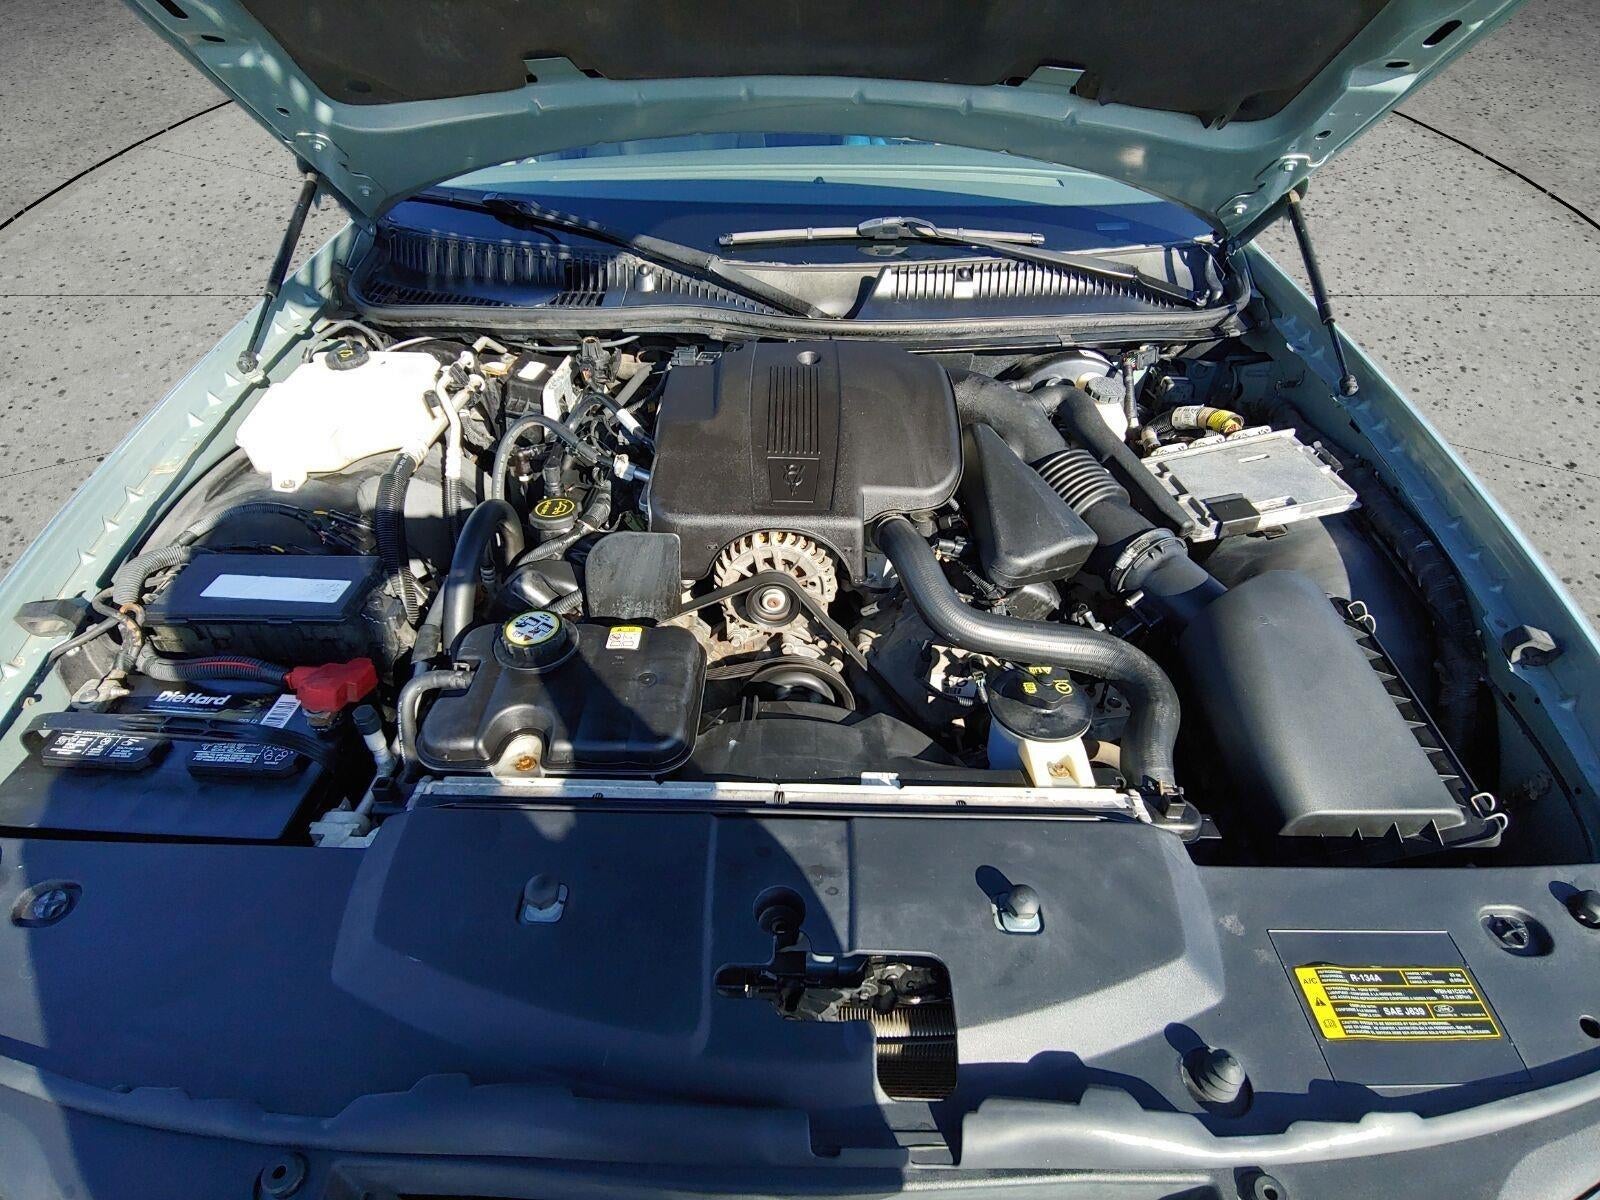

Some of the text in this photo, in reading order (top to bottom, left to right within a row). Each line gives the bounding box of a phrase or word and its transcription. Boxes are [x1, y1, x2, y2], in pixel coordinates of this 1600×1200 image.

[155, 690, 232, 706] DieHard
[1303, 977, 1318, 985] A/C
[1349, 973, 1382, 982] R-134A
[1382, 1006, 1404, 1016] SAE
